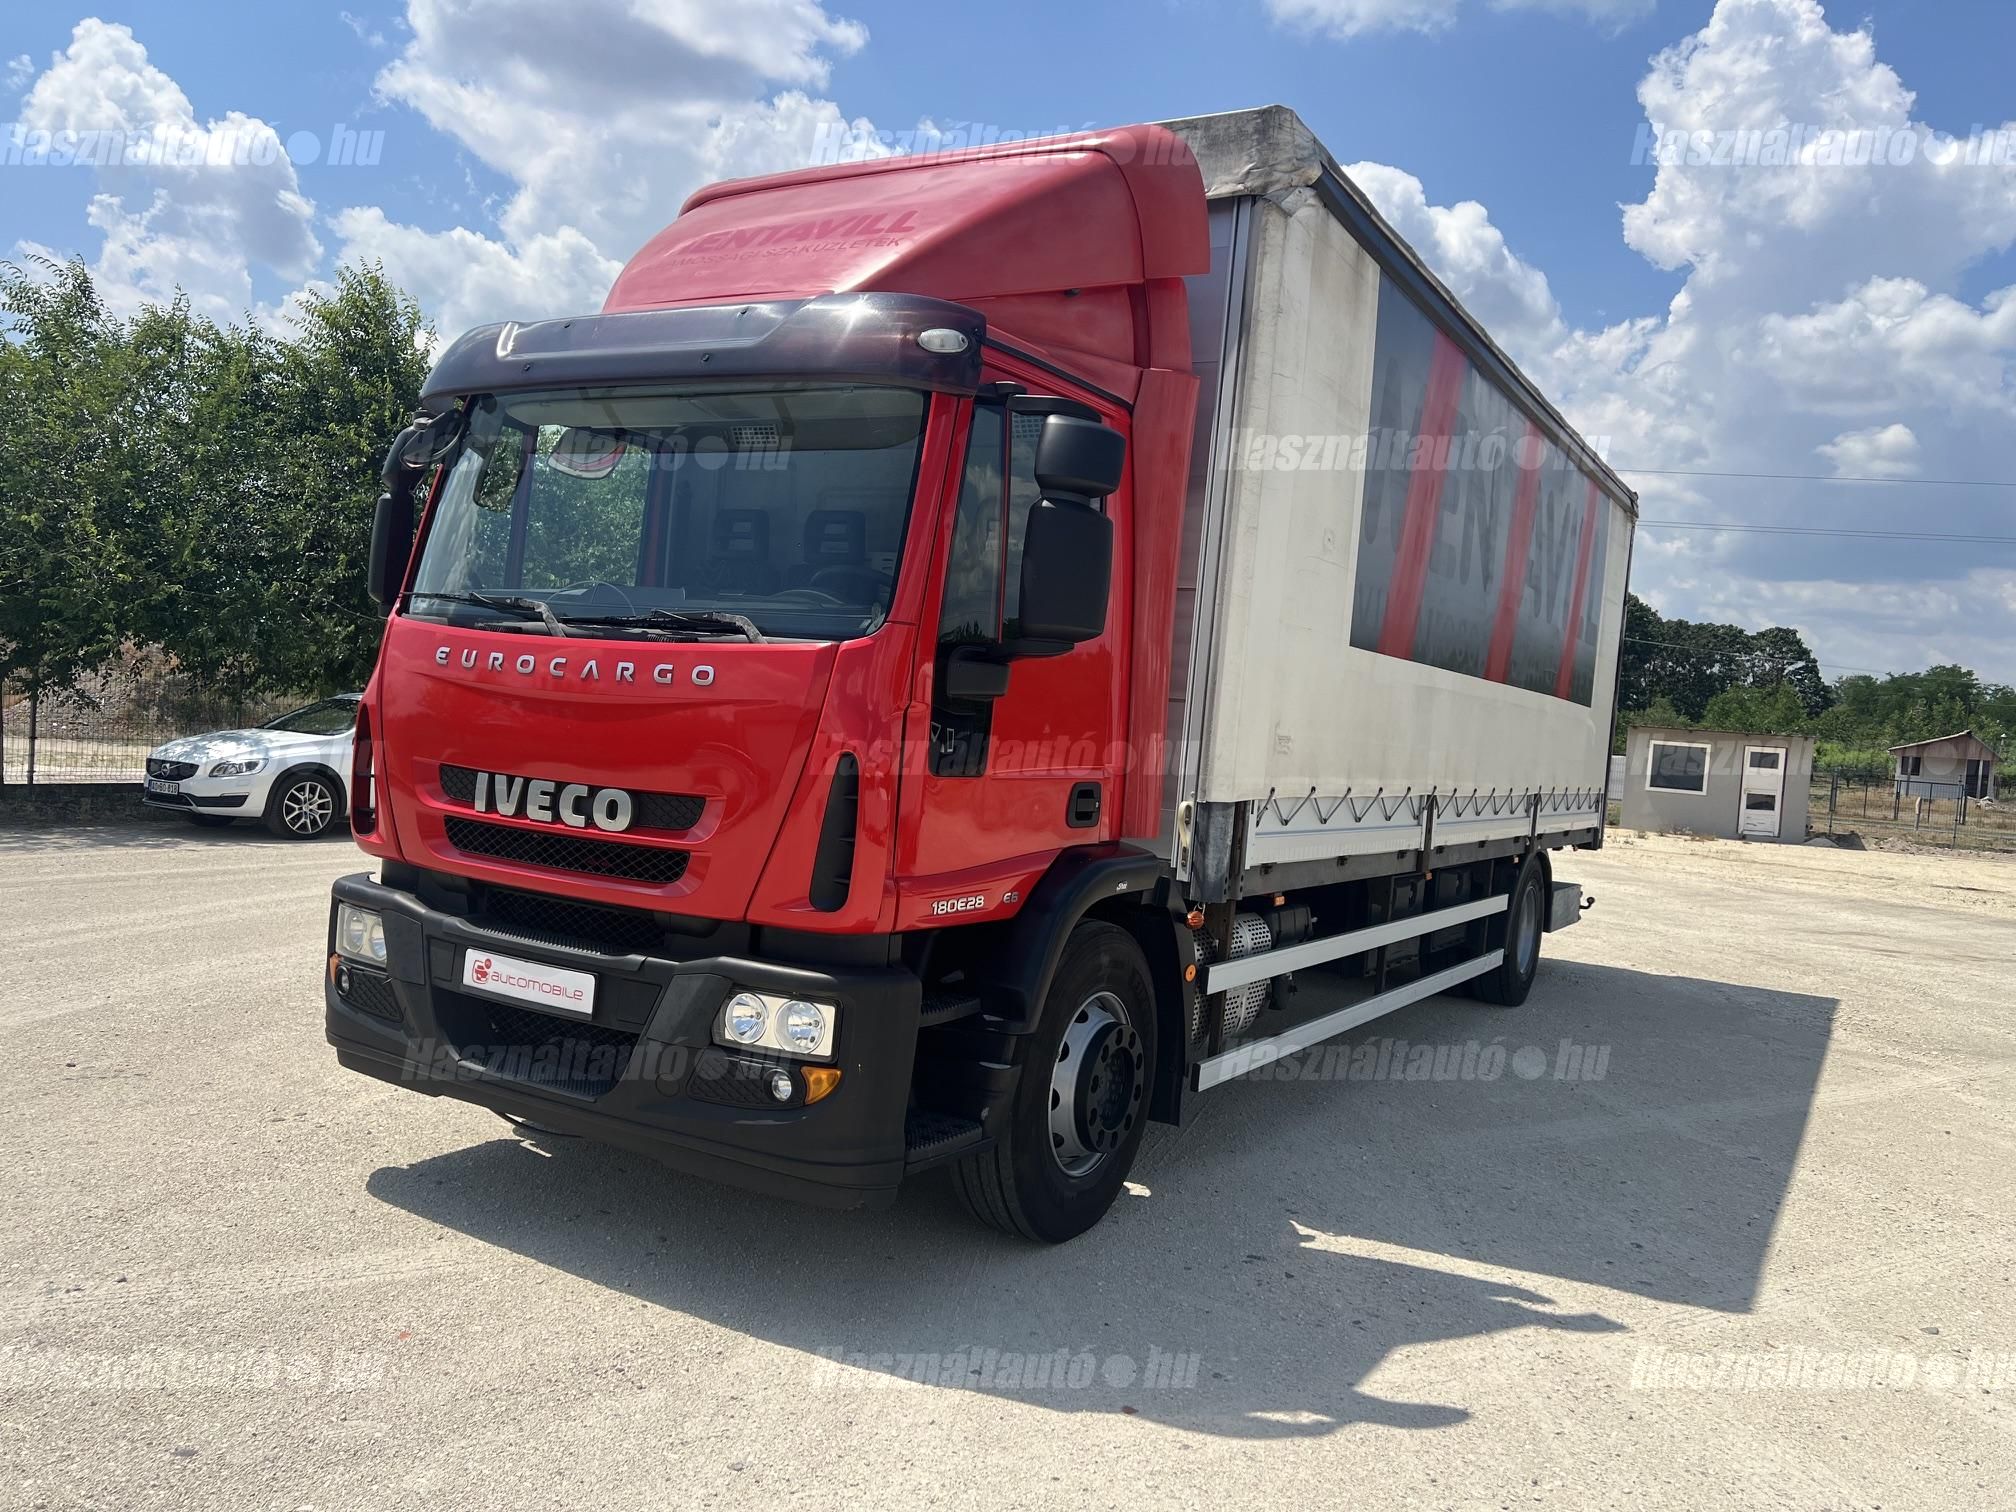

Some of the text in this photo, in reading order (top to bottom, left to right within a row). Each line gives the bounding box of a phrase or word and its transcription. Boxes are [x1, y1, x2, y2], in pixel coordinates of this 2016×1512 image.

[435, 646, 715, 686] EUROCARGO
[474, 771, 633, 832] IVECO
[932, 894, 985, 915] 180E28
